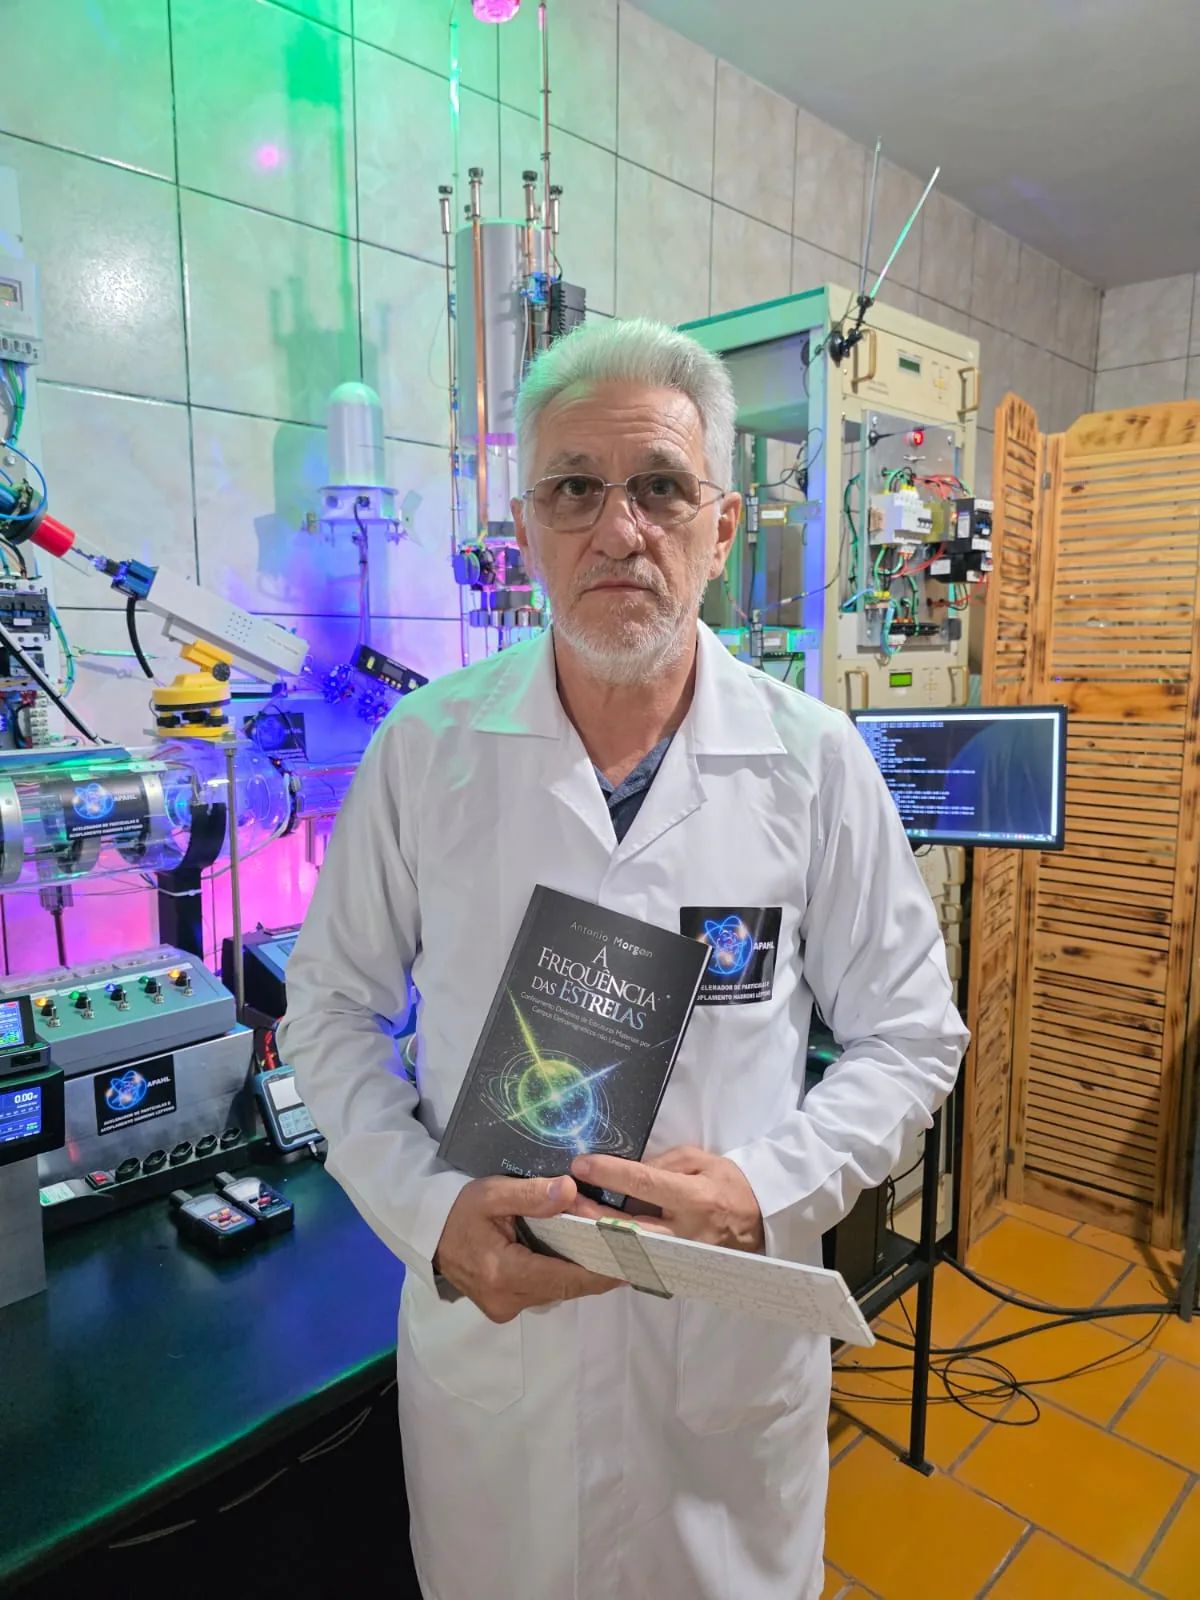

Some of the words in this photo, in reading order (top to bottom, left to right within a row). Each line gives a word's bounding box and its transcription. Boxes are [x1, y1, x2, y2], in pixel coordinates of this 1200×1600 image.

[592, 945, 608, 969] A
[613, 936, 653, 958] Morgan
[537, 946, 657, 1012] FREQUÊNCIA
[700, 983, 733, 991] ELERADOR
[531, 975, 557, 996] DAS
[559, 979, 646, 1031] ESTRELAS
[501, 1158, 524, 1175] Física
